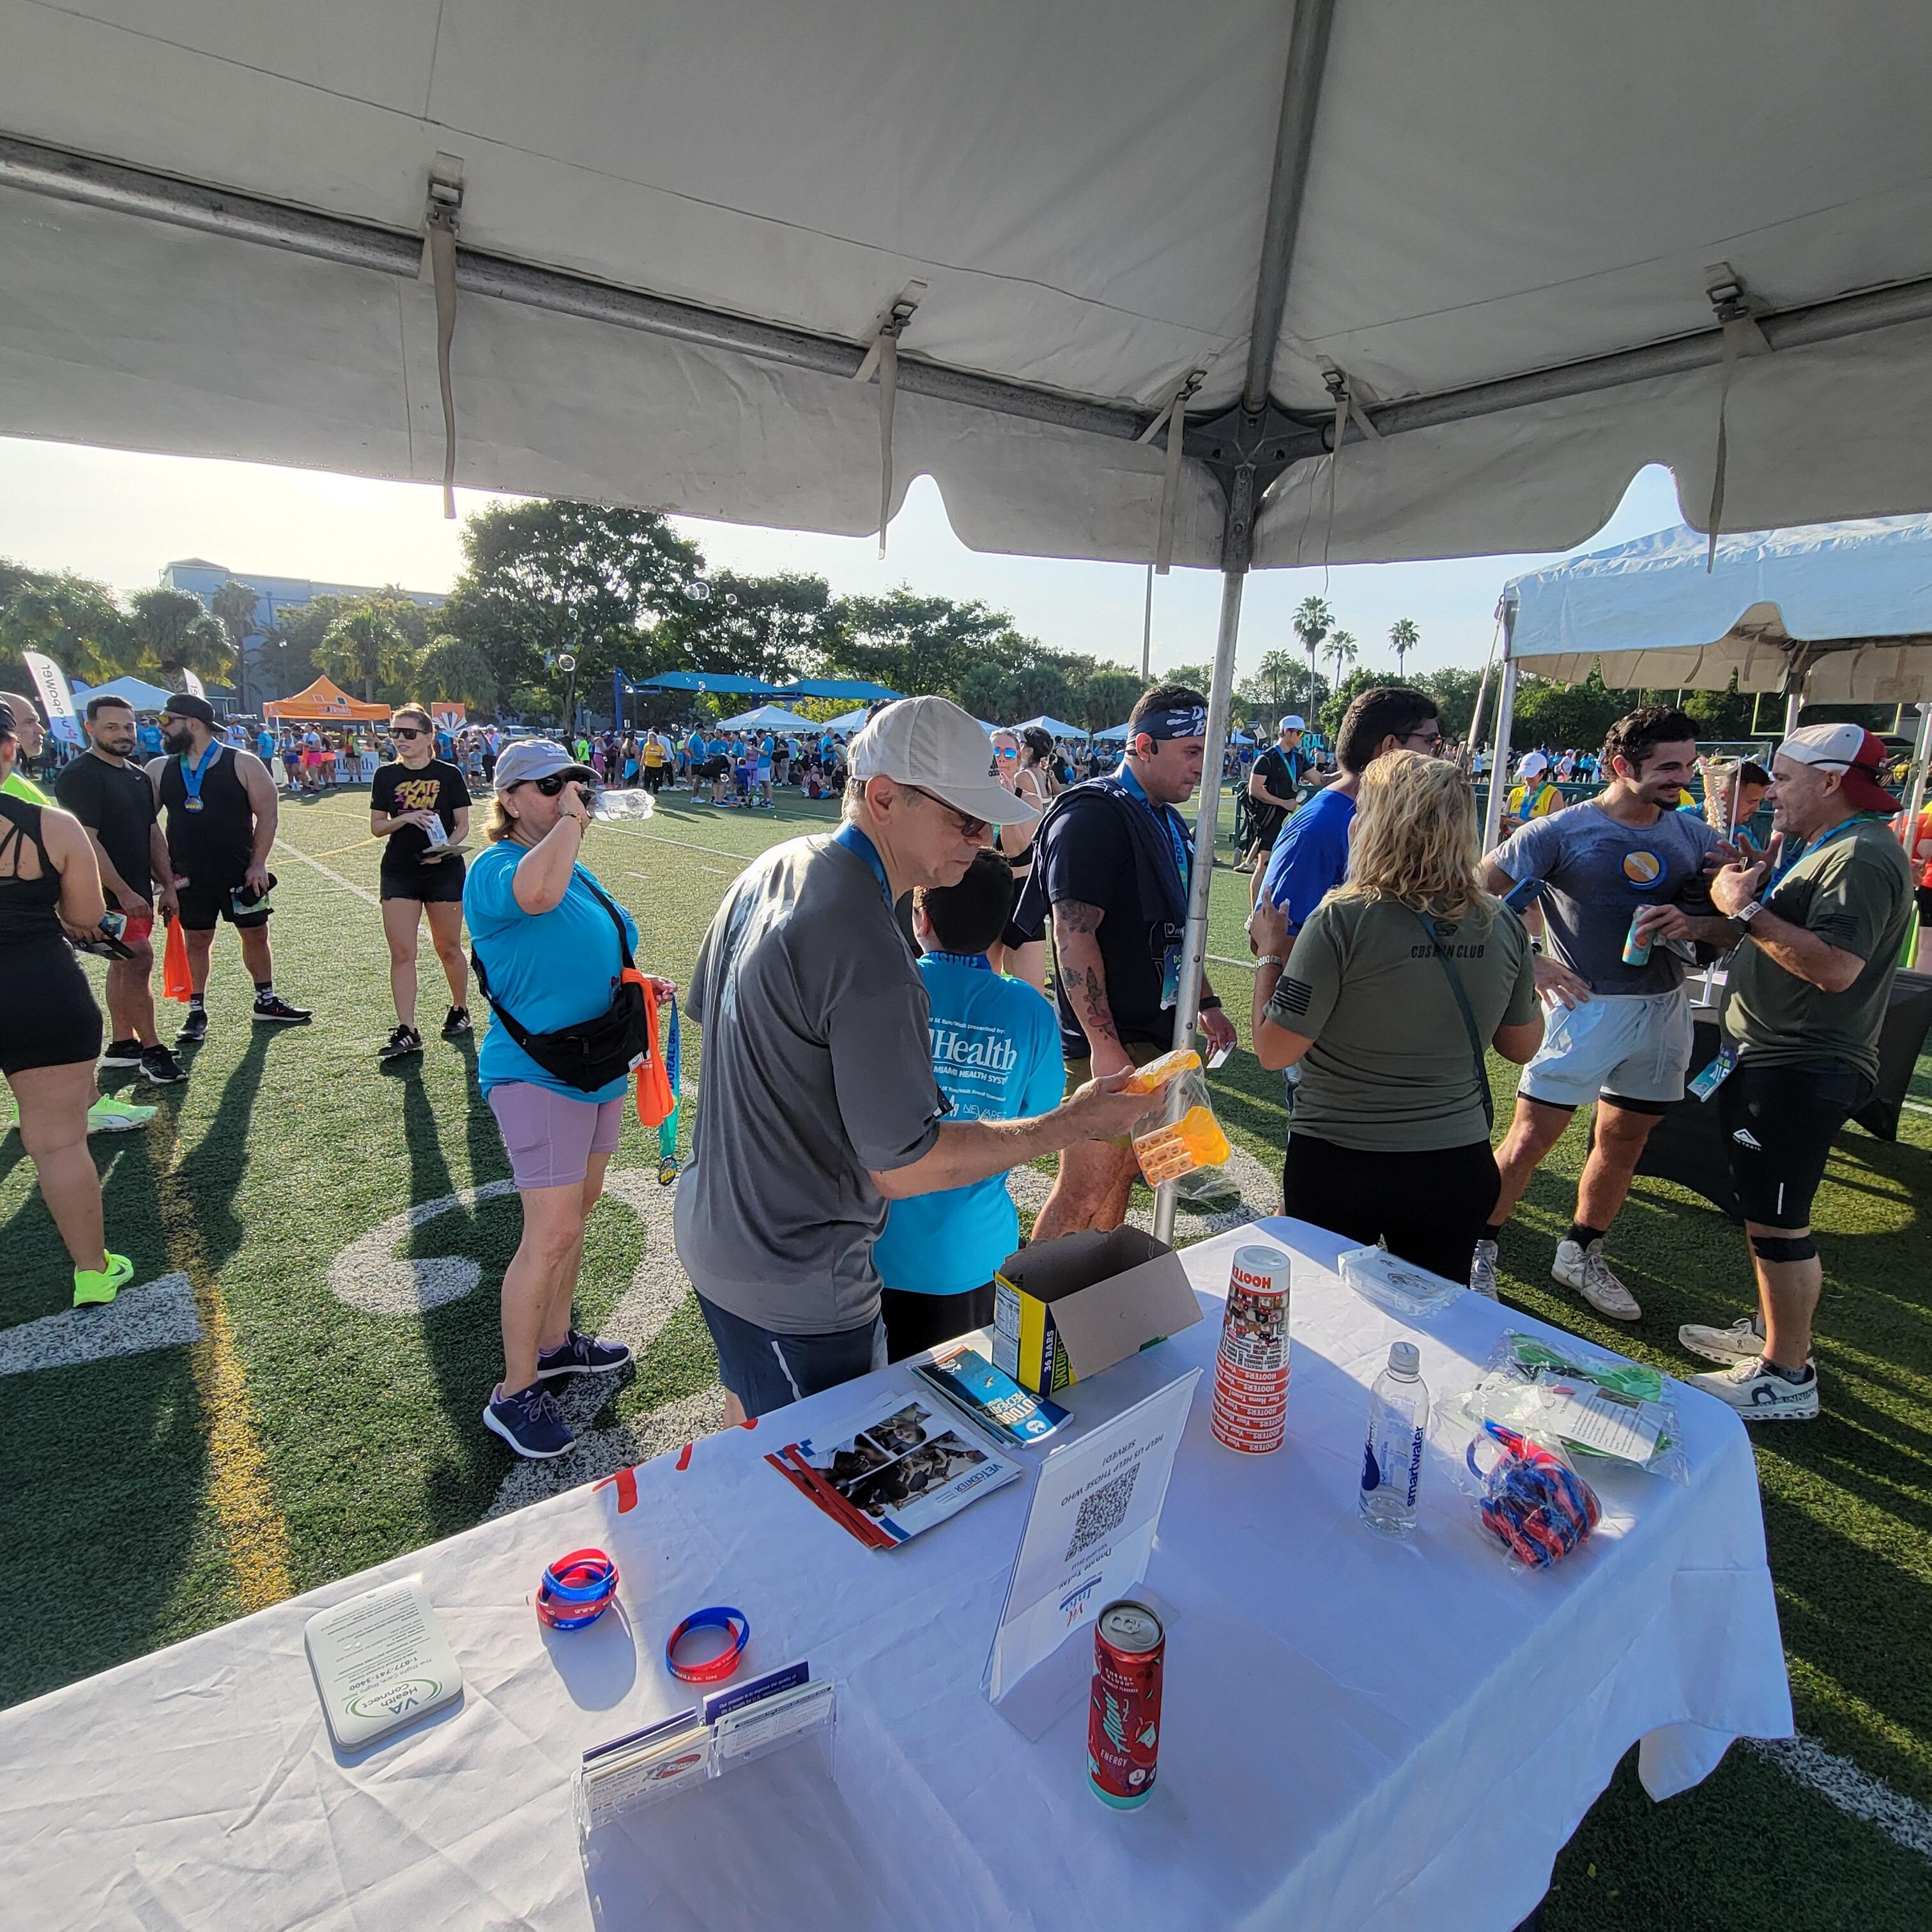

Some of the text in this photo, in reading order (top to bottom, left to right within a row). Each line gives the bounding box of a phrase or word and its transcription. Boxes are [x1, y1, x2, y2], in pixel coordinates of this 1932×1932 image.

[394, 779, 440, 795] SKATE
[402, 792, 439, 809] RUN
[1411, 945, 1431, 958] CDS
[1457, 944, 1485, 959] CLUB
[933, 1065, 1008, 1085] MIAMI HEALTH SYST
[1043, 1330, 1054, 1373] 36 BARS
[1102, 1439, 1137, 1468] SERVED!
[1061, 1434, 1164, 1507] HELP US HELP THOSE WHO
[1407, 1425, 1424, 1508] smartwater
[954, 1472, 985, 1493] CENTER
[1085, 1547, 1112, 1572] Donate
[1059, 1570, 1082, 1591] Today
[360, 1682, 410, 1709] Connect
[380, 1686, 418, 1708] Health
[388, 1697, 420, 1715] VA
[1100, 1748, 1128, 1767] ENERGY
